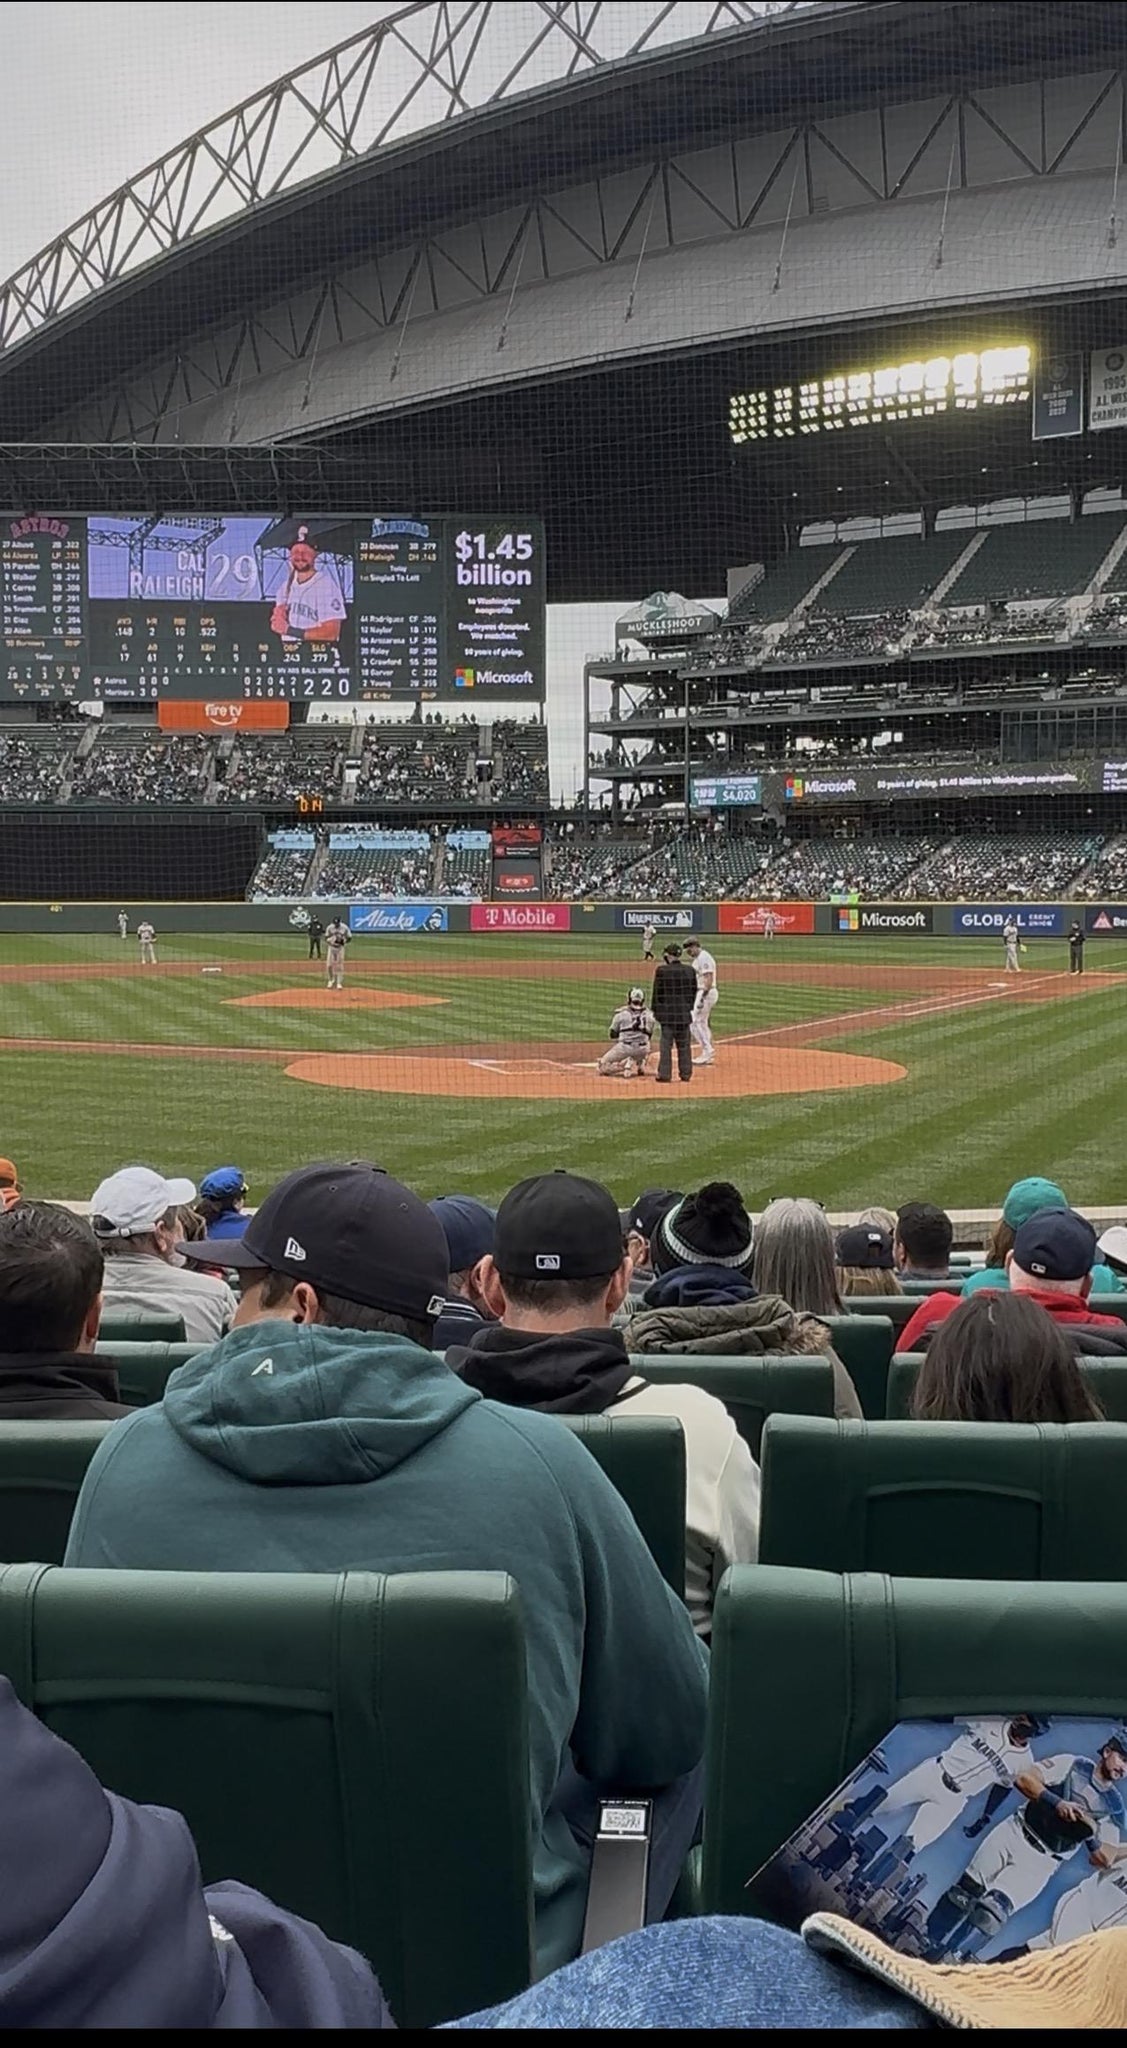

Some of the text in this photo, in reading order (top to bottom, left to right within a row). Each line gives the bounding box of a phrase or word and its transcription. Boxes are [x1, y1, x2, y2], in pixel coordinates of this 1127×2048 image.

[455, 531, 533, 562] $1.45
[178, 550, 205, 571] CAL
[209, 553, 259, 599] 29
[457, 564, 532, 585] billion
[129, 569, 204, 599] RALEIGH
[477, 597, 521, 607] Washington
[175, 627, 186, 636] 10
[458, 622, 497, 632] Employees
[627, 617, 702, 632] MUCKLESHOOT
[120, 653, 130, 662] 17
[147, 653, 157, 662] 61
[474, 649, 492, 657] years
[493, 648, 500, 656] of
[105, 676, 127, 685] Astros
[476, 670, 534, 684] Microsoft
[304, 679, 349, 695] 2 2 0
[205, 703, 243, 717] fire tv
[804, 779, 857, 793] Microsoft
[983, 777, 991, 785] to
[992, 775, 1036, 785] Washington
[722, 789, 757, 802] $4,020
[354, 909, 413, 929] Alaska
[503, 909, 556, 925] Mobile
[861, 912, 926, 927] Microsoft
[962, 914, 1025, 926] GLOBAL
